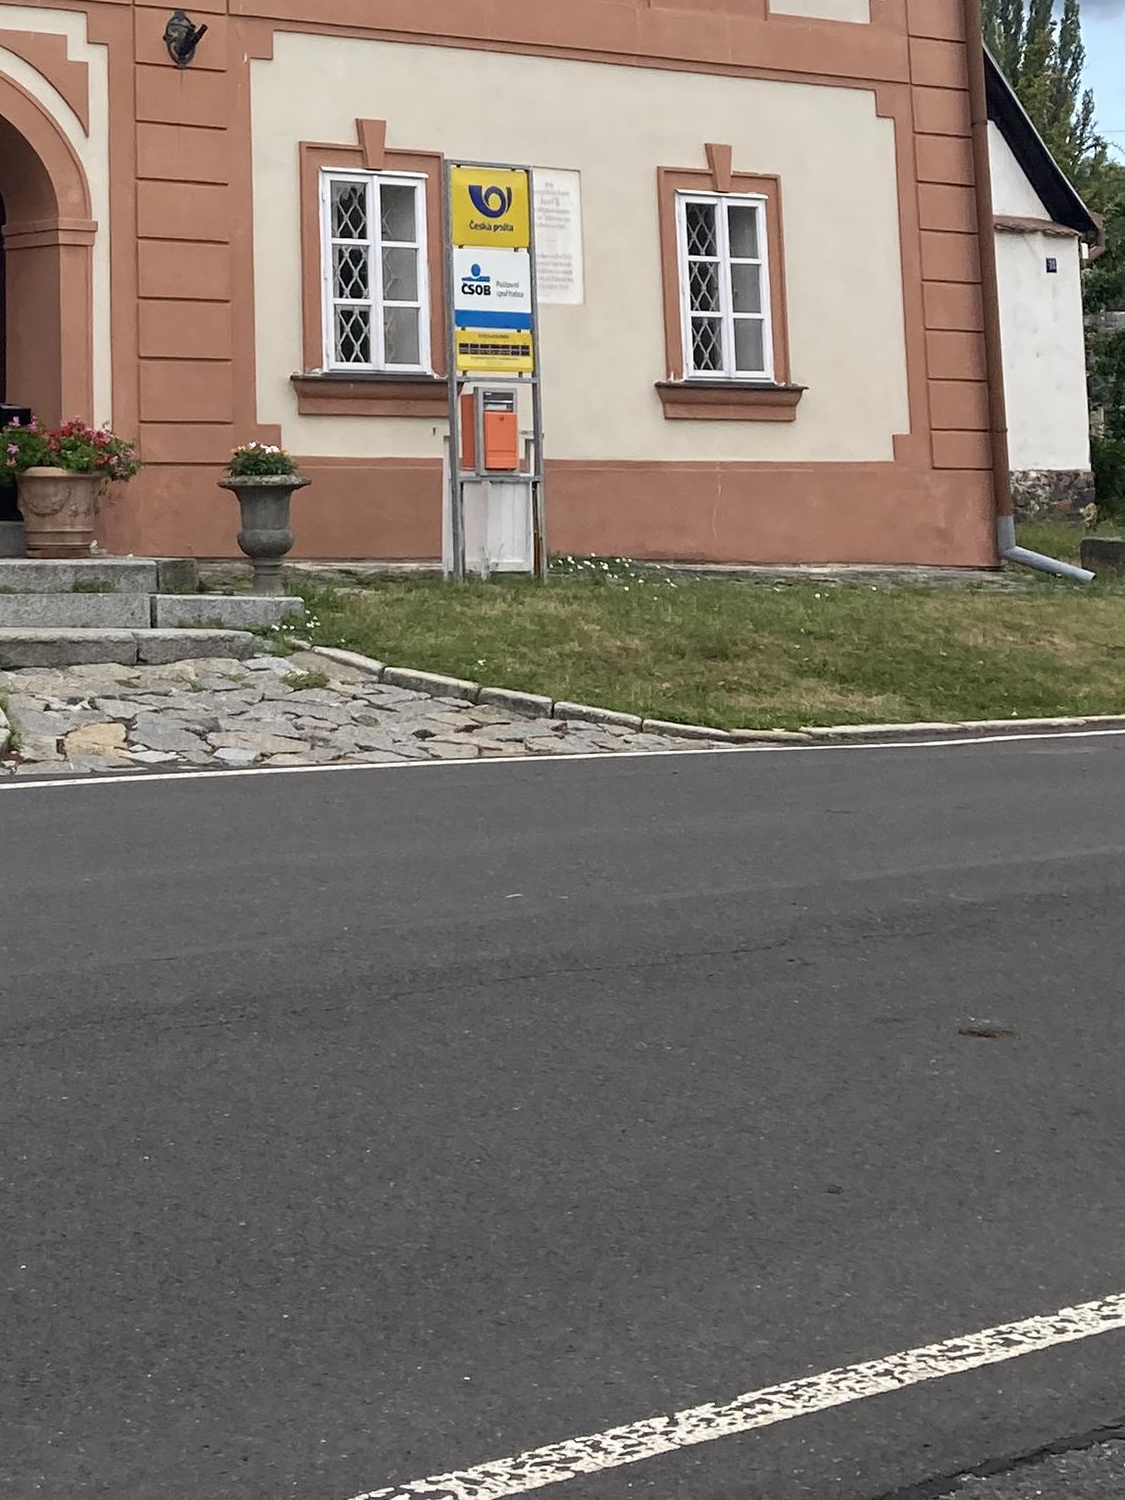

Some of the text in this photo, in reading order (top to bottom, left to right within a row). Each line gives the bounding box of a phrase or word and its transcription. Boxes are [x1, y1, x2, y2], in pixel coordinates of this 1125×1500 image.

[469, 219, 514, 232] Česká pošta
[461, 283, 491, 296] ČSOB
